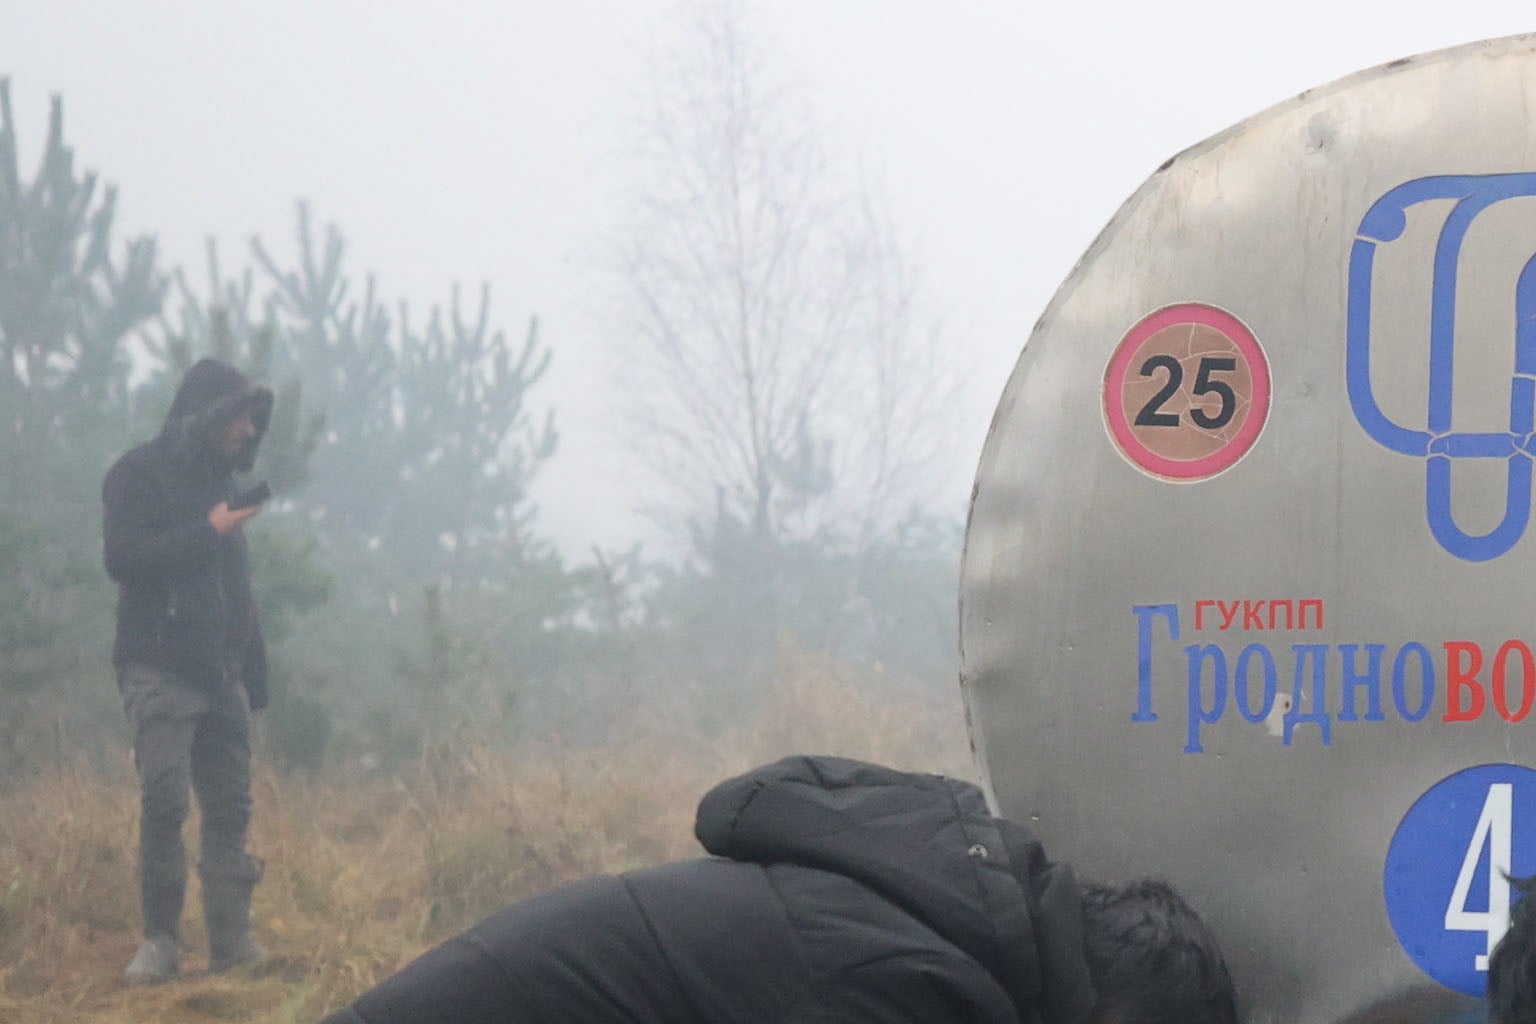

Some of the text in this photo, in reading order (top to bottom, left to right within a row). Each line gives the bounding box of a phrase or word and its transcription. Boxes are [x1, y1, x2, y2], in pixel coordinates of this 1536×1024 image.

[1134, 354, 1236, 430] 25
[1194, 598, 1325, 632] ГУКПП
[1444, 783, 1514, 971] 4
